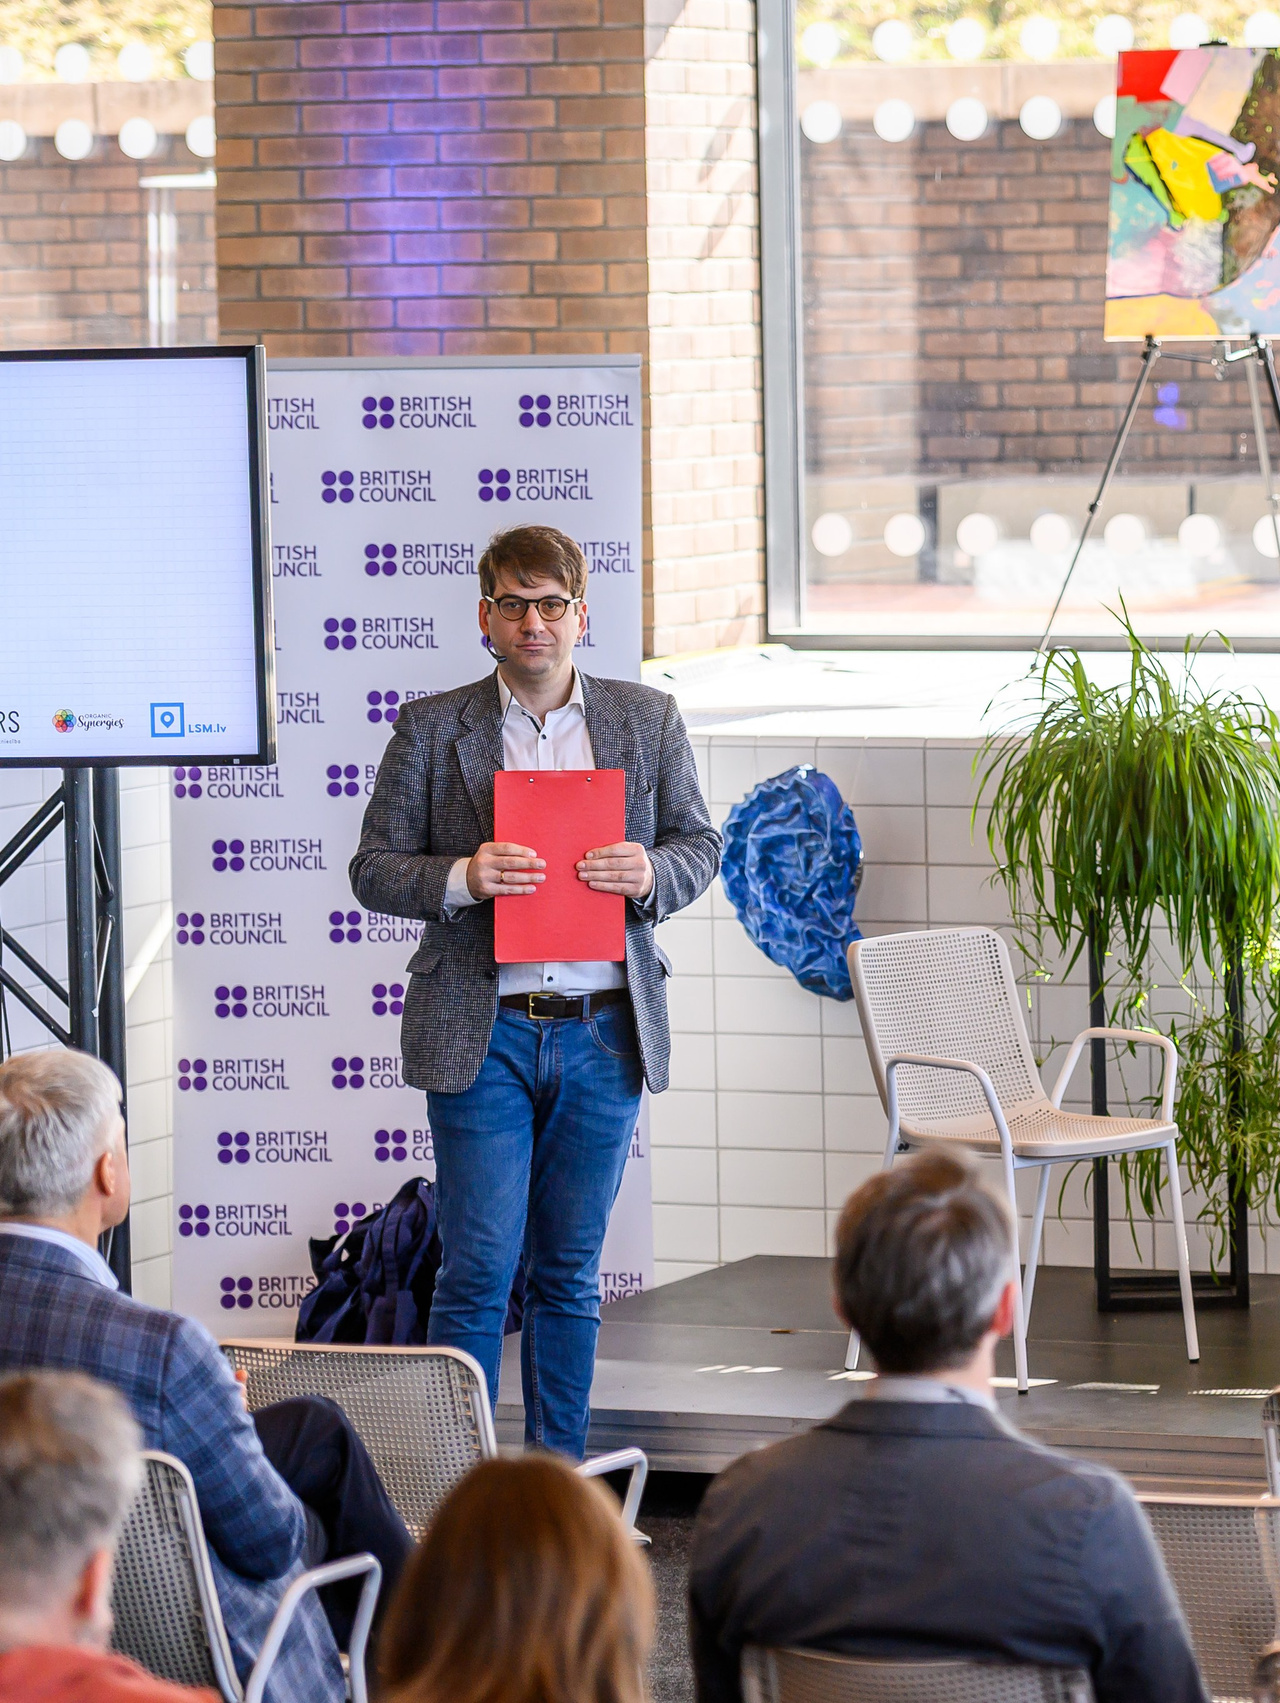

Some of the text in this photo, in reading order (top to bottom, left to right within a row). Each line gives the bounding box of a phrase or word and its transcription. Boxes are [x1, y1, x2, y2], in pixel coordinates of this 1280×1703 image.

[268, 398, 314, 412] ITISH
[400, 397, 471, 411] BRITISH
[557, 395, 628, 410] BRITISH
[268, 415, 320, 429] UNCIL
[400, 413, 477, 428] COUNCIL
[556, 411, 633, 426] COUNCIL
[360, 470, 431, 485] BRITISH
[517, 469, 588, 484] BRITISH
[359, 487, 436, 502] COUNCIL
[516, 485, 593, 500] COUNCIL
[273, 545, 317, 560] TISH
[403, 544, 473, 558] BRITISH
[272, 562, 322, 577] UNCIL
[363, 617, 433, 632] BRITISH
[362, 634, 439, 649] COUNCIL
[277, 692, 320, 707] TISH
[77, 715, 124, 732] Synergies
[188, 723, 227, 734] LSM.lv
[208, 767, 278, 781] BRITISH
[207, 783, 284, 798] COUNCIL
[251, 839, 322, 854] BRITISH
[250, 856, 327, 871] COUNCIL
[211, 913, 281, 928] BRITISH
[210, 929, 287, 944] COUNCIL
[253, 985, 324, 1000] BRITISH
[253, 1002, 330, 1017] COUNCIL
[213, 1059, 284, 1073] BRITISH
[213, 1075, 290, 1090] COUNCIL
[256, 1131, 327, 1146] BRITISH
[255, 1148, 332, 1163] COUNCIL
[216, 1204, 287, 1219] BRITISH
[215, 1221, 292, 1236] COUNCIL
[258, 1277, 317, 1292] BRITIS
[601, 1273, 643, 1288] TISH
